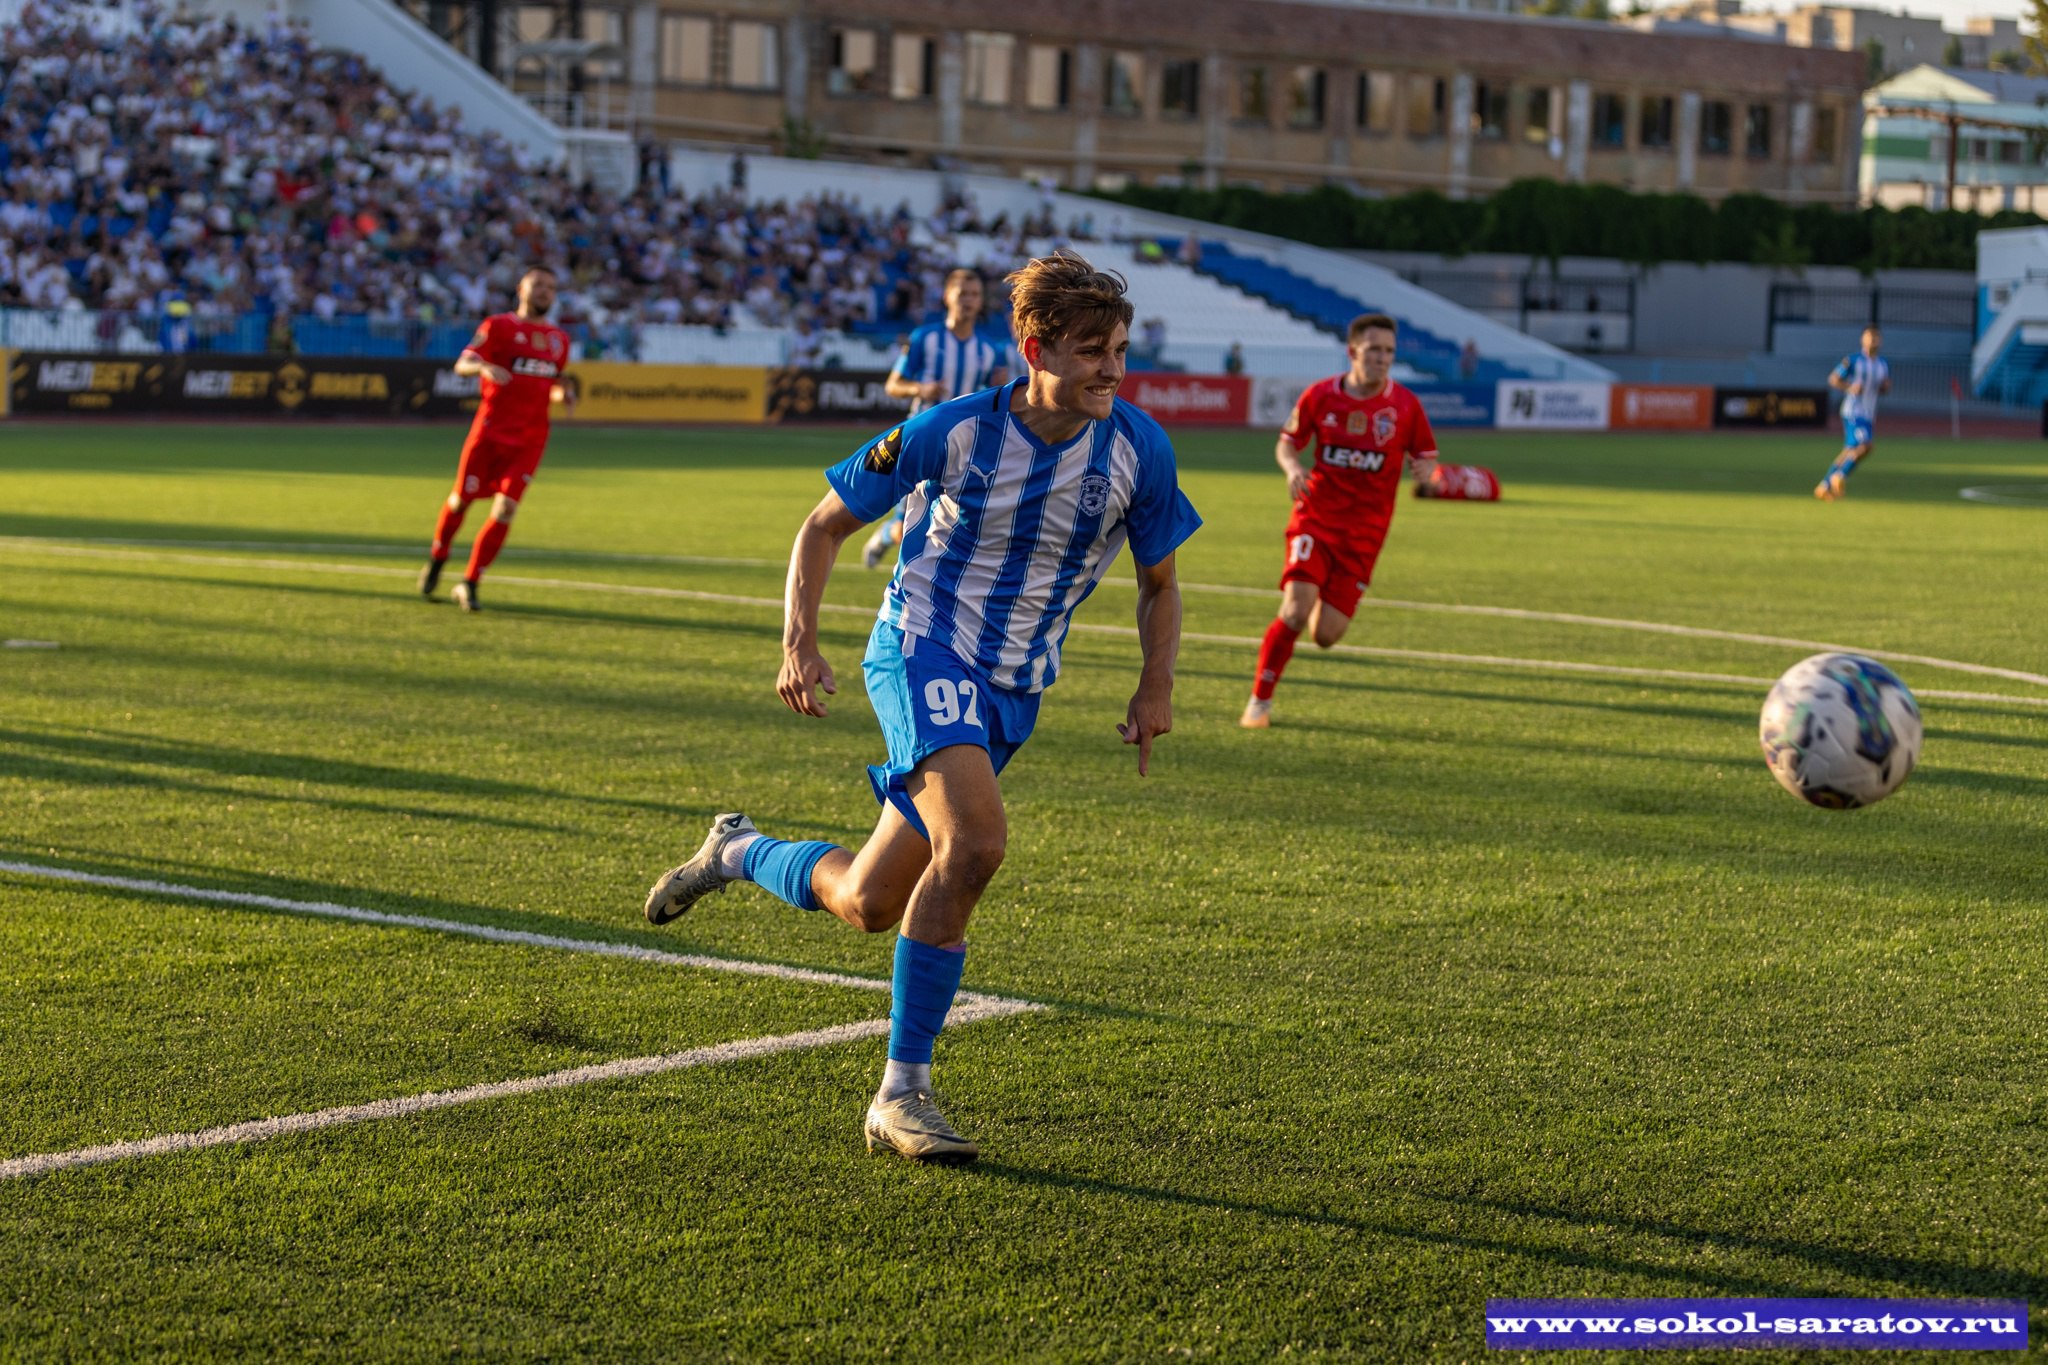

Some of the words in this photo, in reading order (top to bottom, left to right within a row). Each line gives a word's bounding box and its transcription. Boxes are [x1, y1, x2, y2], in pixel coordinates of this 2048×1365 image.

[1323, 445, 1385, 472] LEON
[1289, 533, 1314, 565] 10
[924, 678, 984, 730] 92
